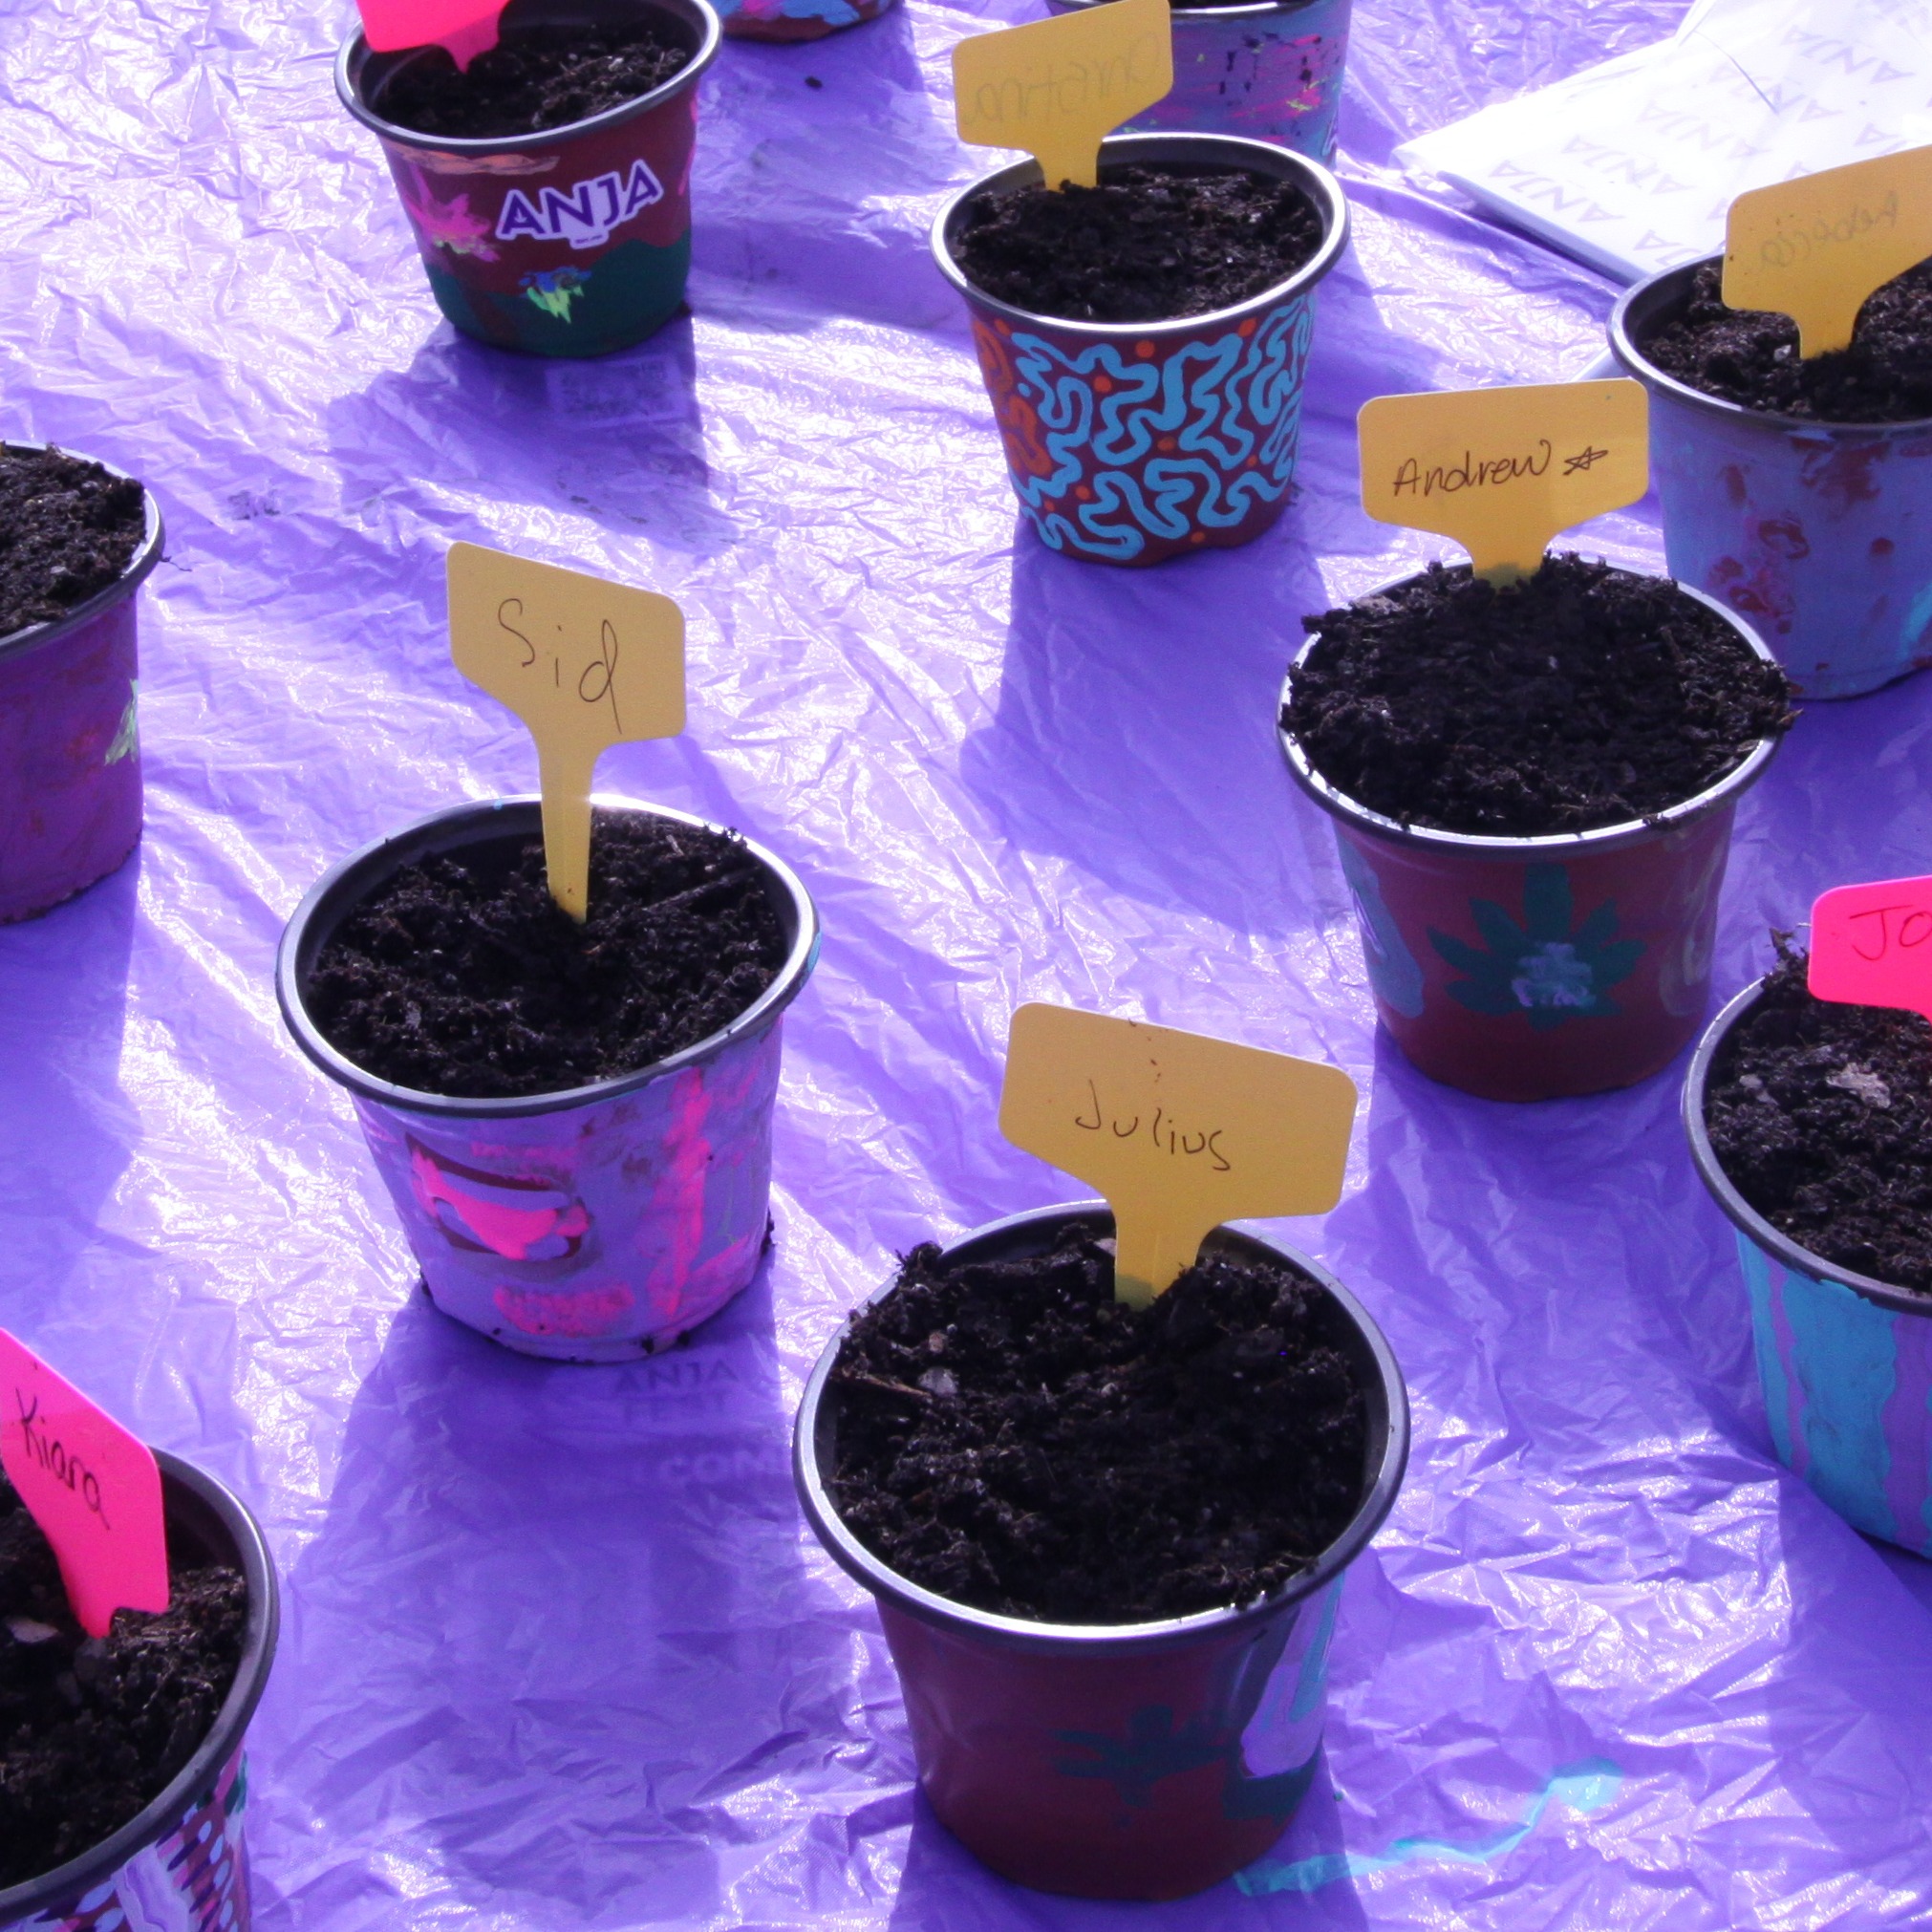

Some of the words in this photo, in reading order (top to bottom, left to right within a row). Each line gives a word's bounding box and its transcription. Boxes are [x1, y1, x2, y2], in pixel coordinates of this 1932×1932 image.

[498, 161, 661, 236] ANJA
[1488, 159, 1627, 224] ANJA
[1392, 439, 1552, 498] Andrew
[497, 597, 623, 735] Sid
[1075, 1079, 1231, 1171] Julius
[15, 1387, 111, 1531] Kiara
